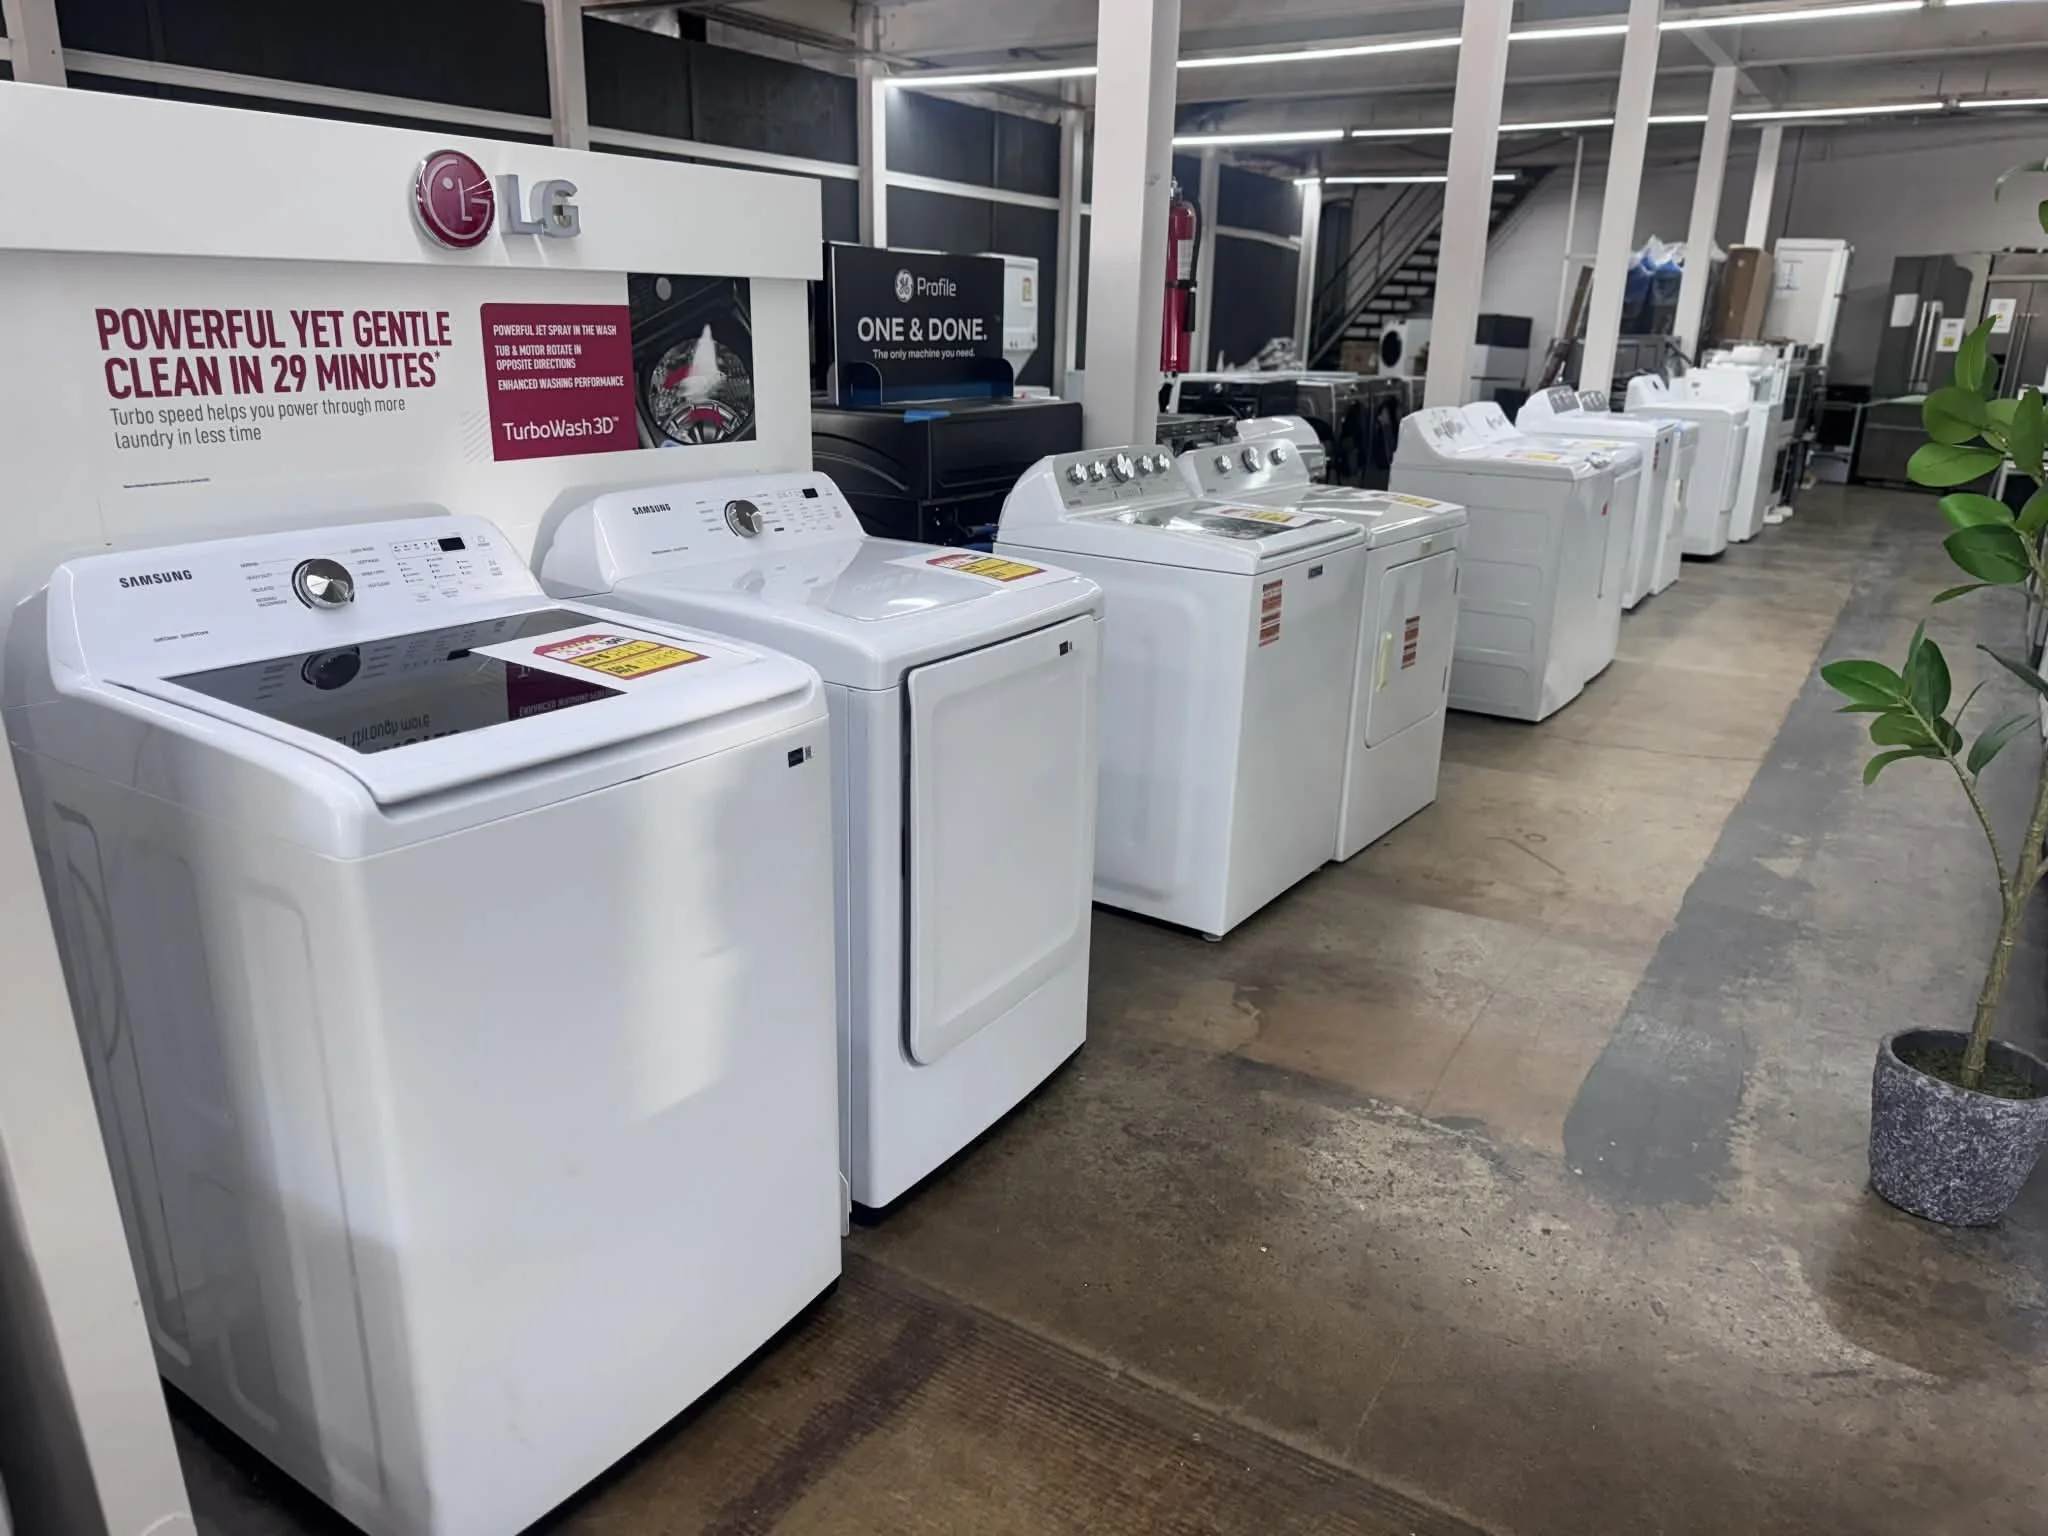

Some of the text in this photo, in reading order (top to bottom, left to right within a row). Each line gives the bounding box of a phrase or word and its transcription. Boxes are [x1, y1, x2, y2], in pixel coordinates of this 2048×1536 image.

[495, 173, 581, 239] LG
[916, 276, 957, 297] Profile
[95, 308, 453, 351] POWERFUL YET GENTLE
[493, 324, 617, 336] POWERFUL JET SPRAY IN THE WASH
[857, 316, 988, 342] ONE & DONE.
[494, 344, 582, 356] TUB & MOTOR ROTATE IN
[872, 348, 976, 361] The only machine you need.
[496, 358, 576, 370] OPPOSITE DIRECTIONS
[104, 355, 223, 400] CLEAN
[229, 355, 264, 395] IN
[270, 354, 307, 393] 29
[498, 375, 625, 391] ENHANCED WASHING PERFORMANCE
[110, 398, 406, 426] Turbo speed helps you power through more
[115, 425, 262, 449] laundry in less time
[632, 503, 671, 516] SAMSUNG
[119, 569, 193, 588] SAMSUNG
